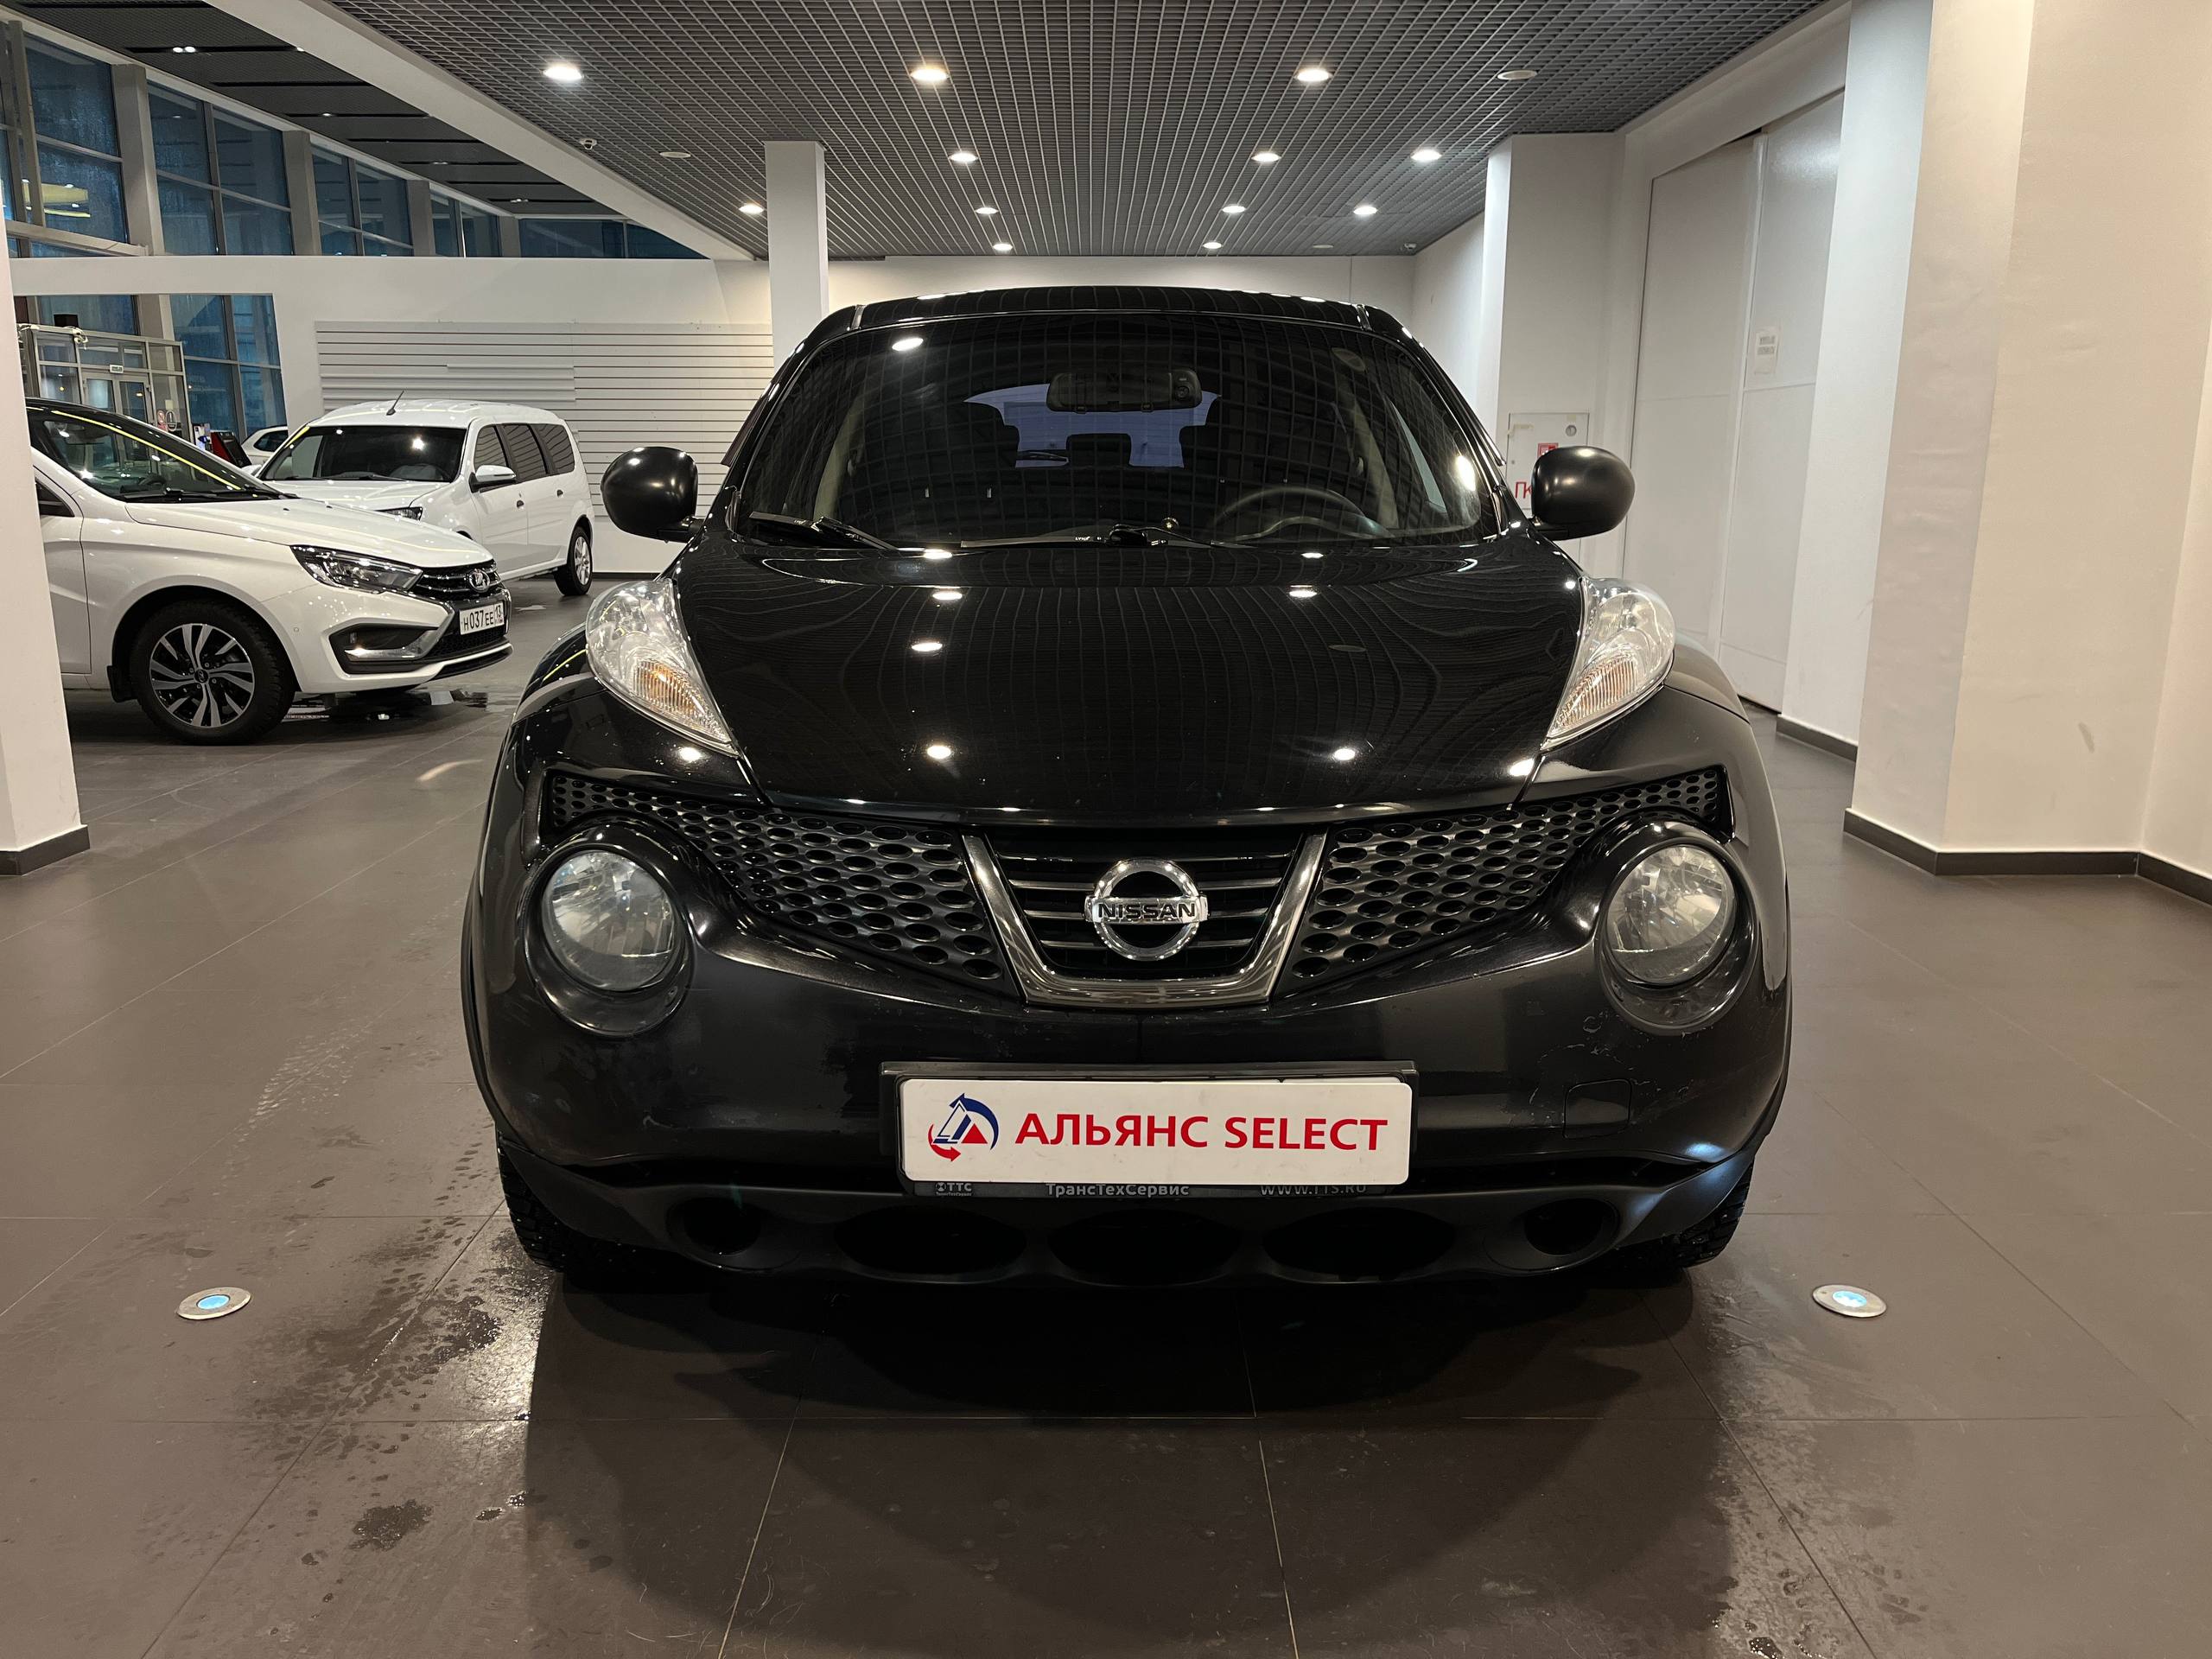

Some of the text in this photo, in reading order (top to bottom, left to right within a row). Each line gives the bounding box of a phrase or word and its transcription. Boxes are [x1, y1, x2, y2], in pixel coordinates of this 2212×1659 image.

[1097, 903, 1196, 918] NISSAN
[1014, 1112, 1389, 1151] АЛЬЯНС SELECT
[1046, 1183, 1190, 1198] ТрансТехСервис
